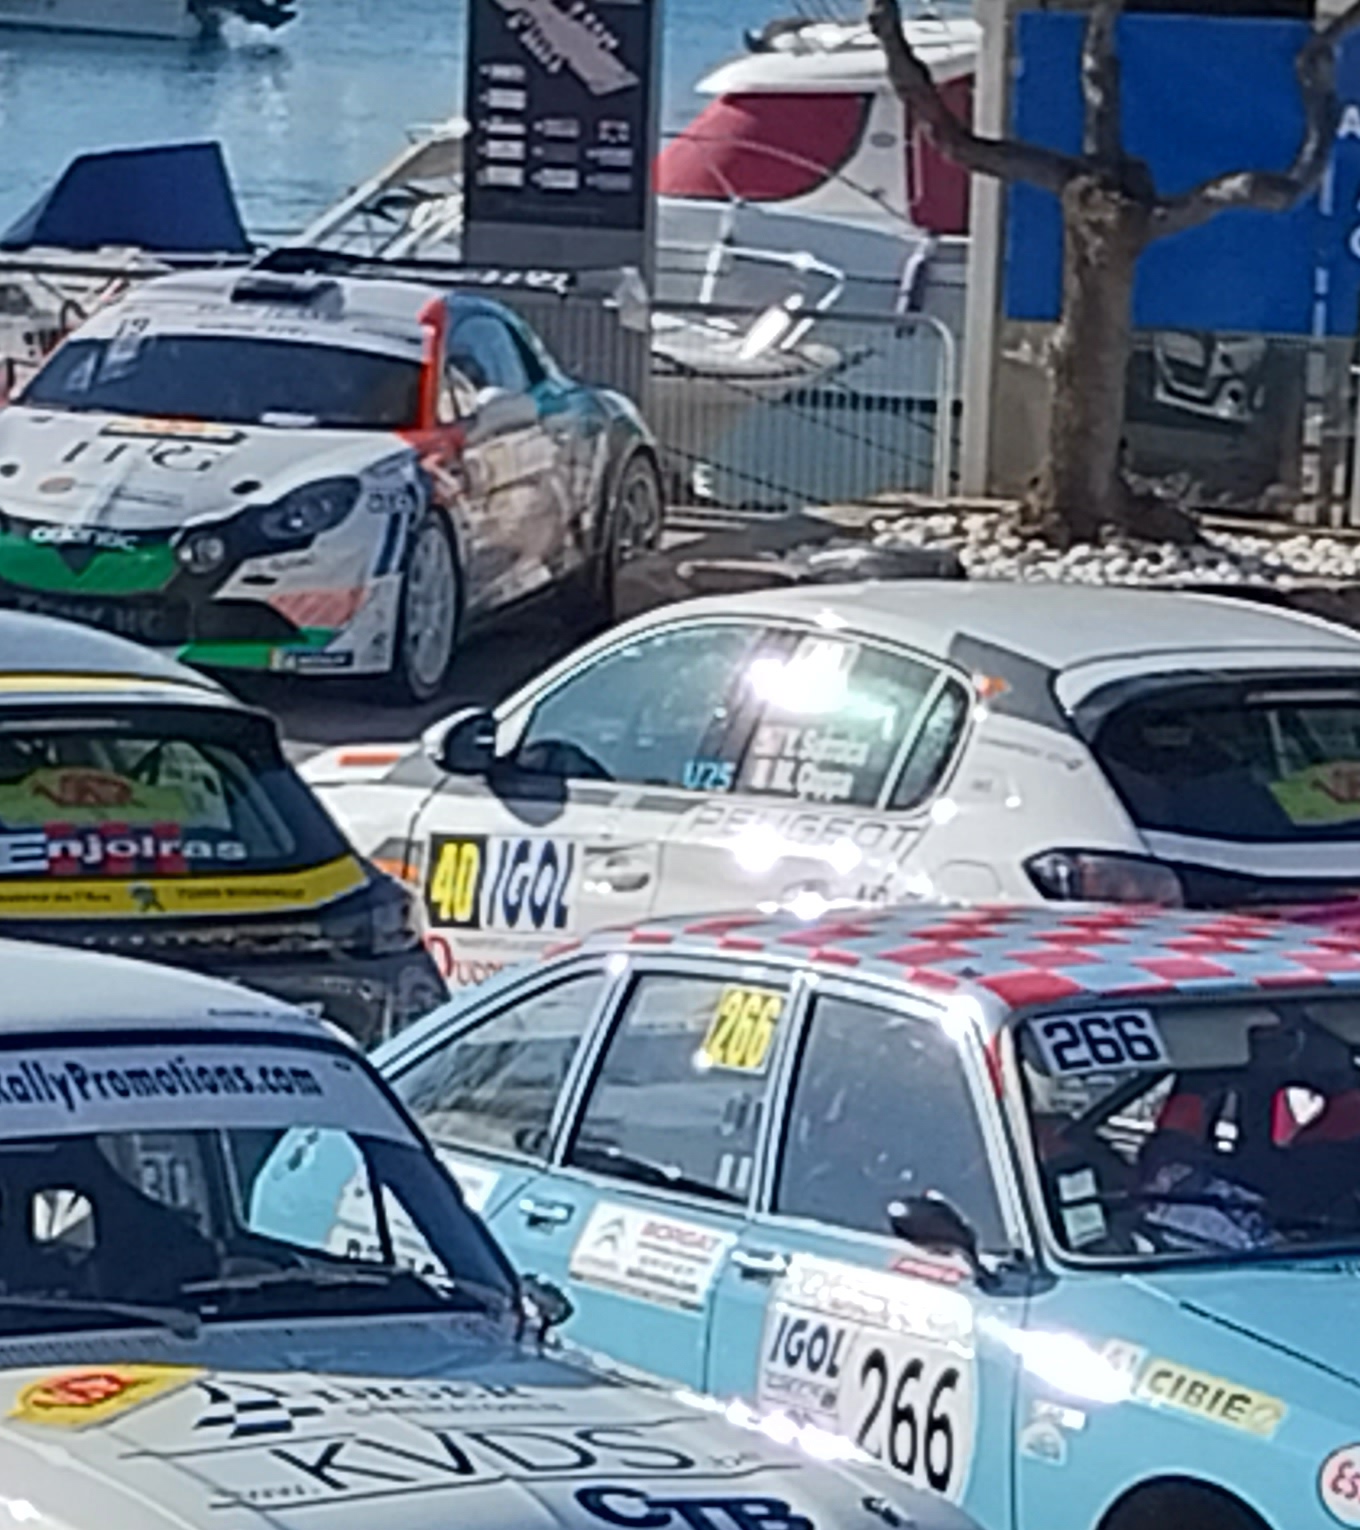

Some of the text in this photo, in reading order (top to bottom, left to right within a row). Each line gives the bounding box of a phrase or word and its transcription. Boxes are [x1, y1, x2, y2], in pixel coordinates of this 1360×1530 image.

[683, 759, 736, 792] U25
[430, 841, 481, 923] 40
[486, 839, 576, 930] IGOL
[709, 990, 784, 1068] 266
[1044, 1015, 1160, 1072] 266
[769, 1315, 847, 1379] IGOL
[857, 1348, 960, 1493] 266
[1148, 1366, 1253, 1423] CIBIE
[269, 1426, 697, 1490] KVDS
